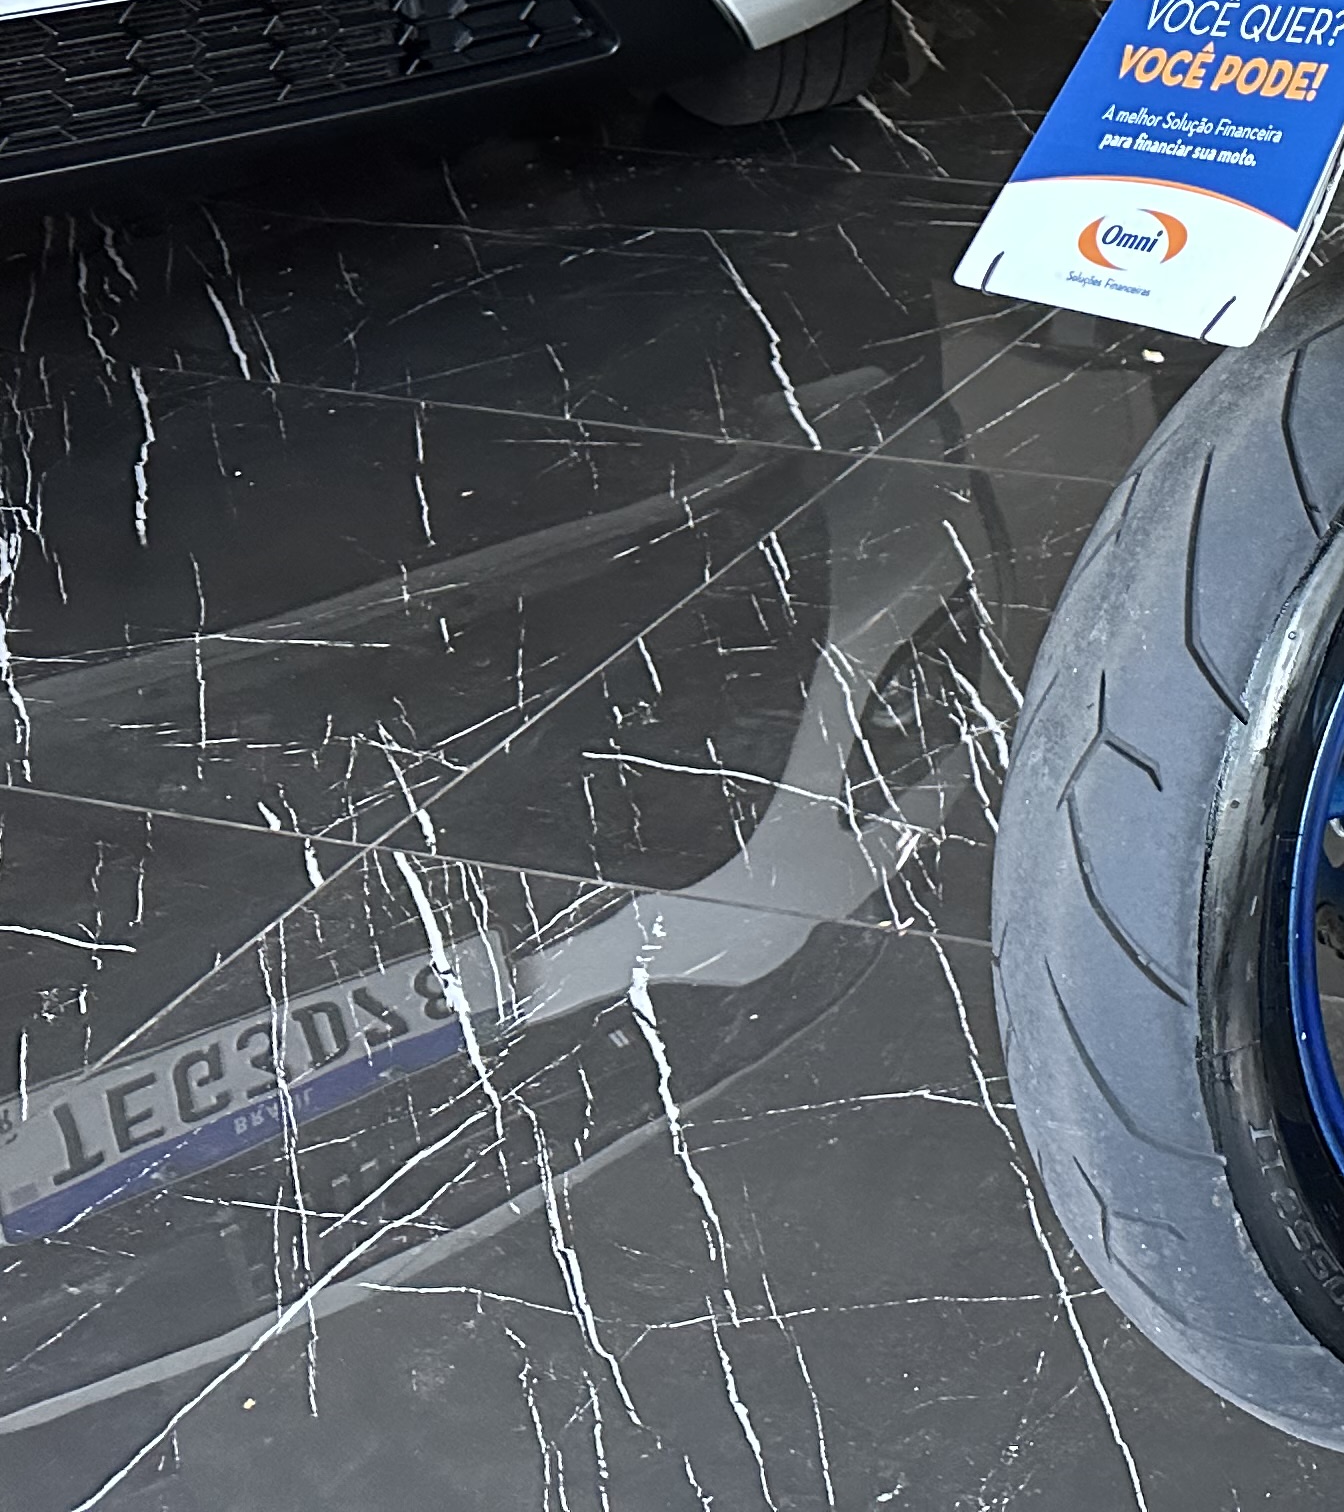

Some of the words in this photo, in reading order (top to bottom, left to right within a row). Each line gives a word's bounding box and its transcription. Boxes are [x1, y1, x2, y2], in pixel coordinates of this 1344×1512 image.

[1118, 41, 1216, 90] VOCÊ
[1210, 55, 1330, 103] PODE!
[1101, 104, 1116, 121] A
[1115, 107, 1163, 127] melhor
[1162, 111, 1214, 138] Solução
[1214, 118, 1283, 144] Financeira
[1098, 133, 1133, 150] para
[1133, 132, 1194, 159] financiar
[1191, 144, 1217, 162] sua
[1216, 147, 1258, 168] moto.
[1101, 224, 1164, 253] Omni
[1066, 270, 1103, 288] Soluções
[1104, 278, 1151, 297] Financeiras
